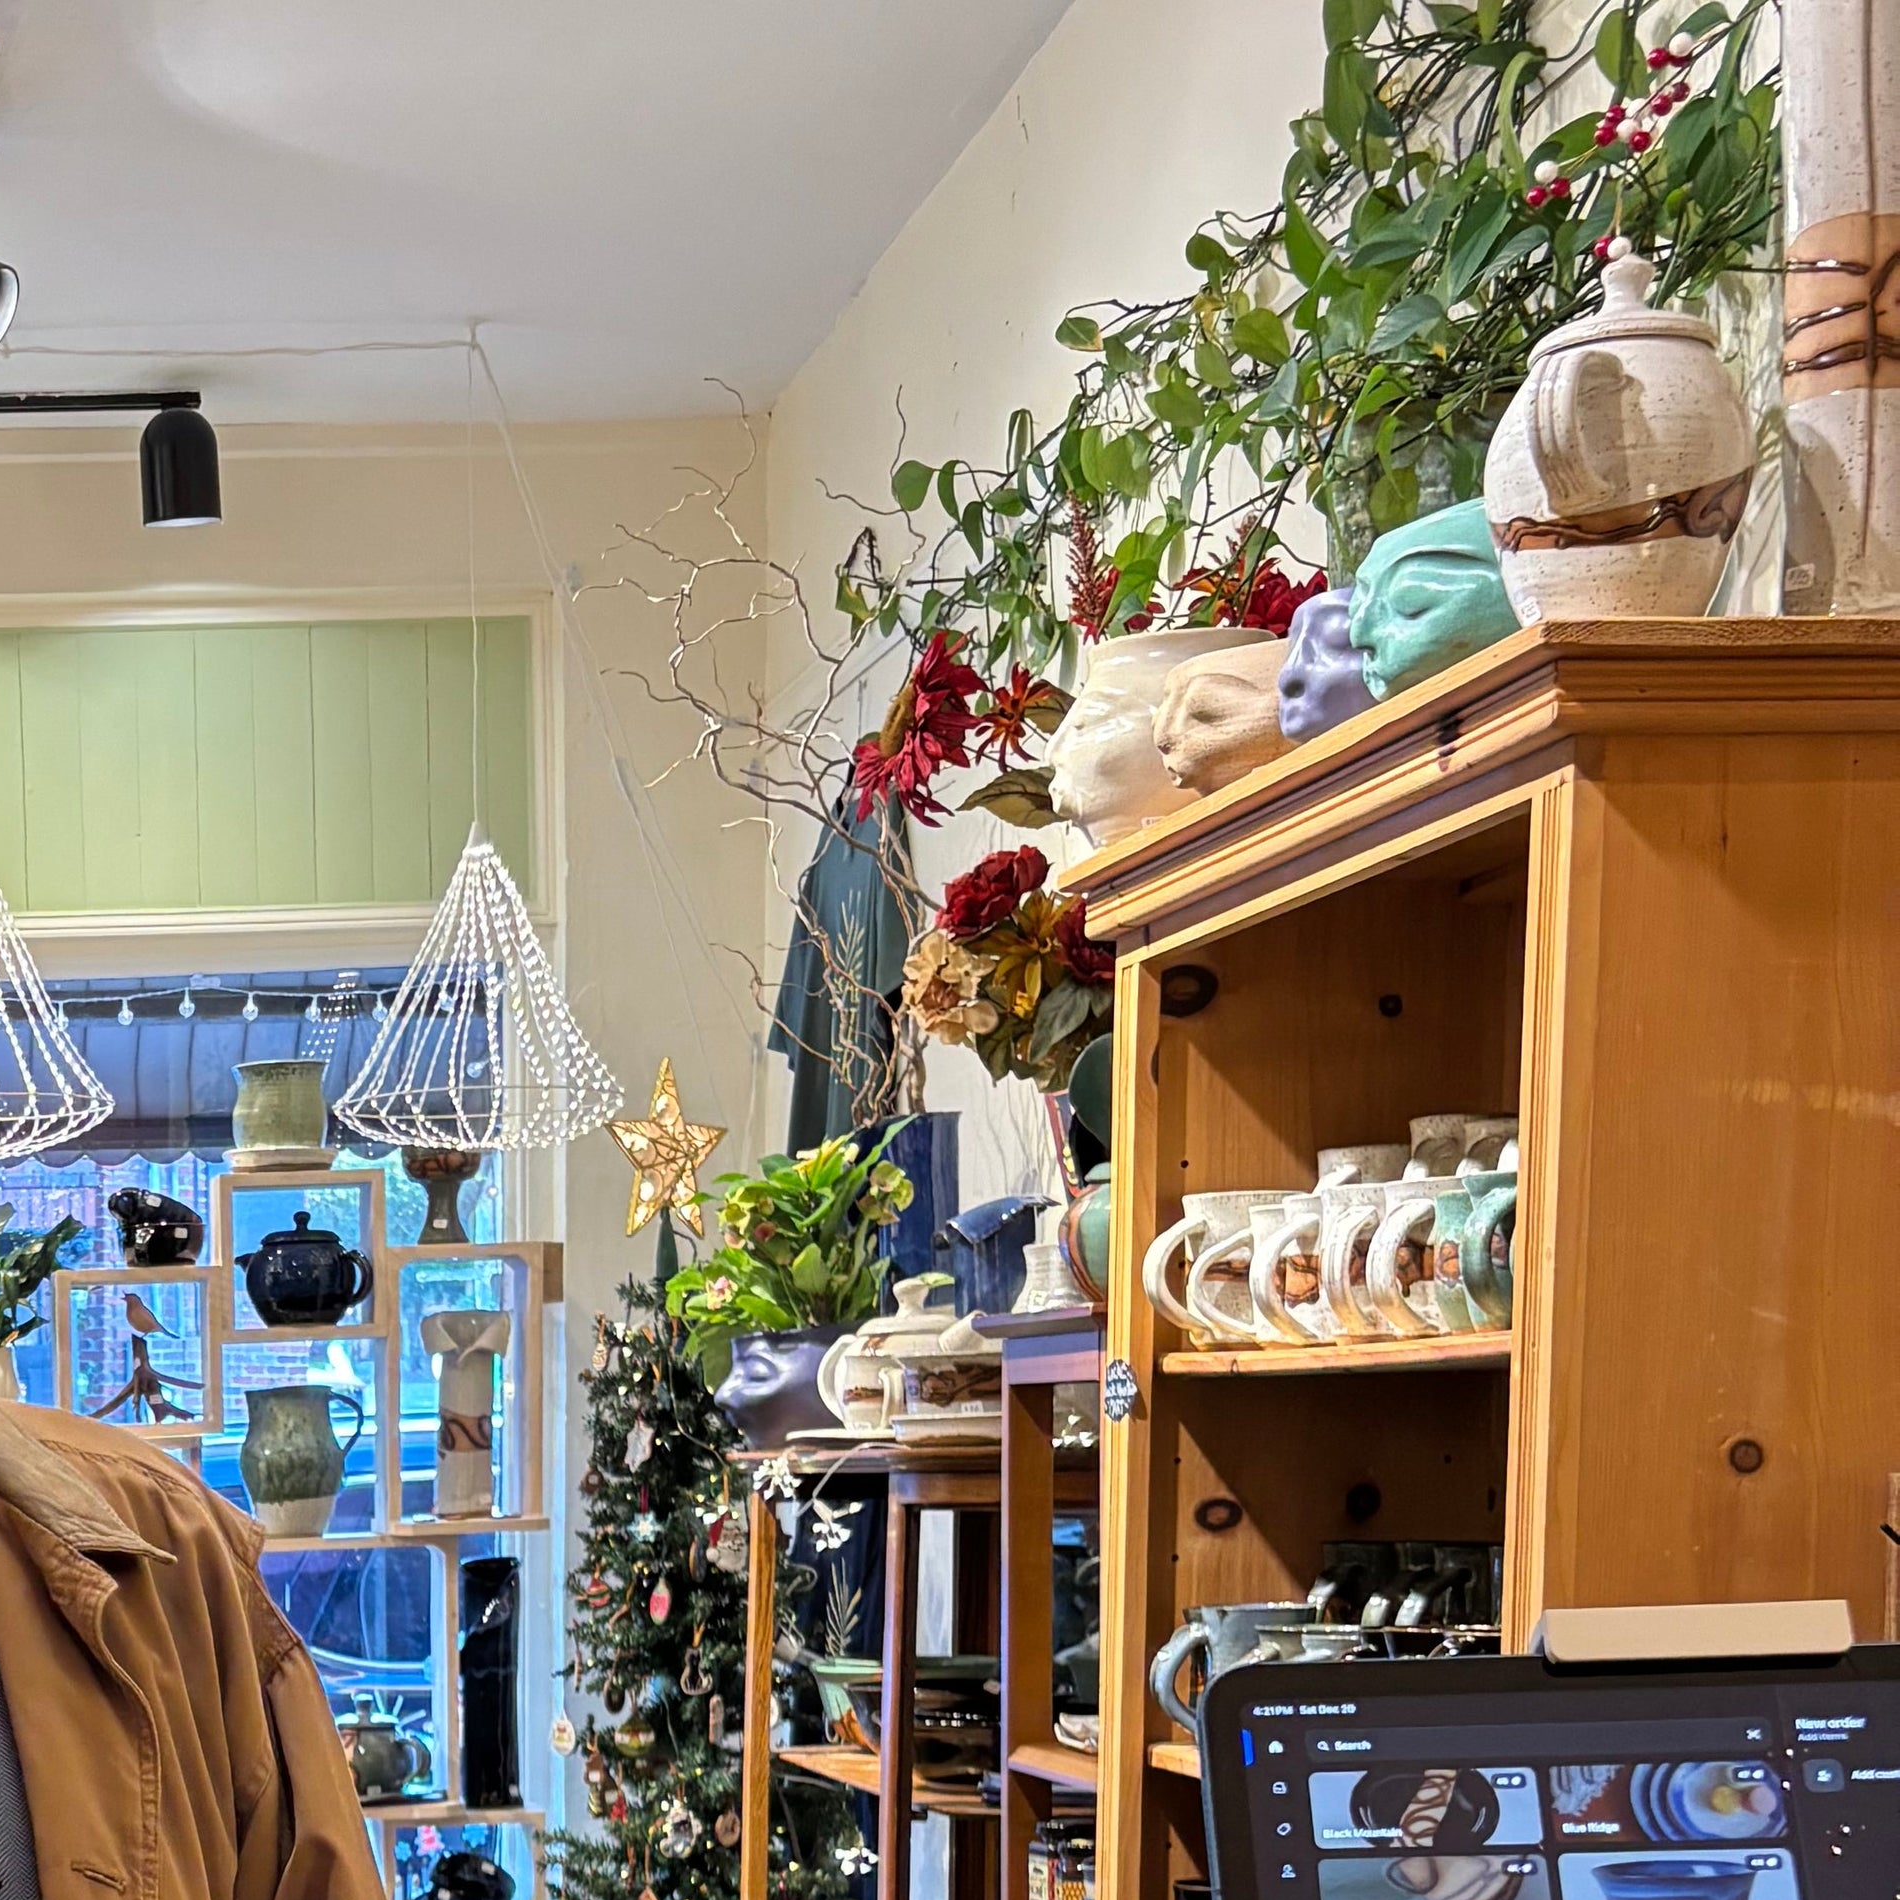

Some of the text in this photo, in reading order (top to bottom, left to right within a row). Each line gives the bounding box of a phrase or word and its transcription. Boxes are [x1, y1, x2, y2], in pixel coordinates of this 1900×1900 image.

[1795, 1716, 1866, 1730] New order
[1798, 1733, 1818, 1742] Add
[1334, 1740, 1372, 1752] Search
[1851, 1769, 1874, 1781] Add
[1322, 1827, 1403, 1839] Black Mountain
[1562, 1822, 1619, 1835] Blue Ridge
